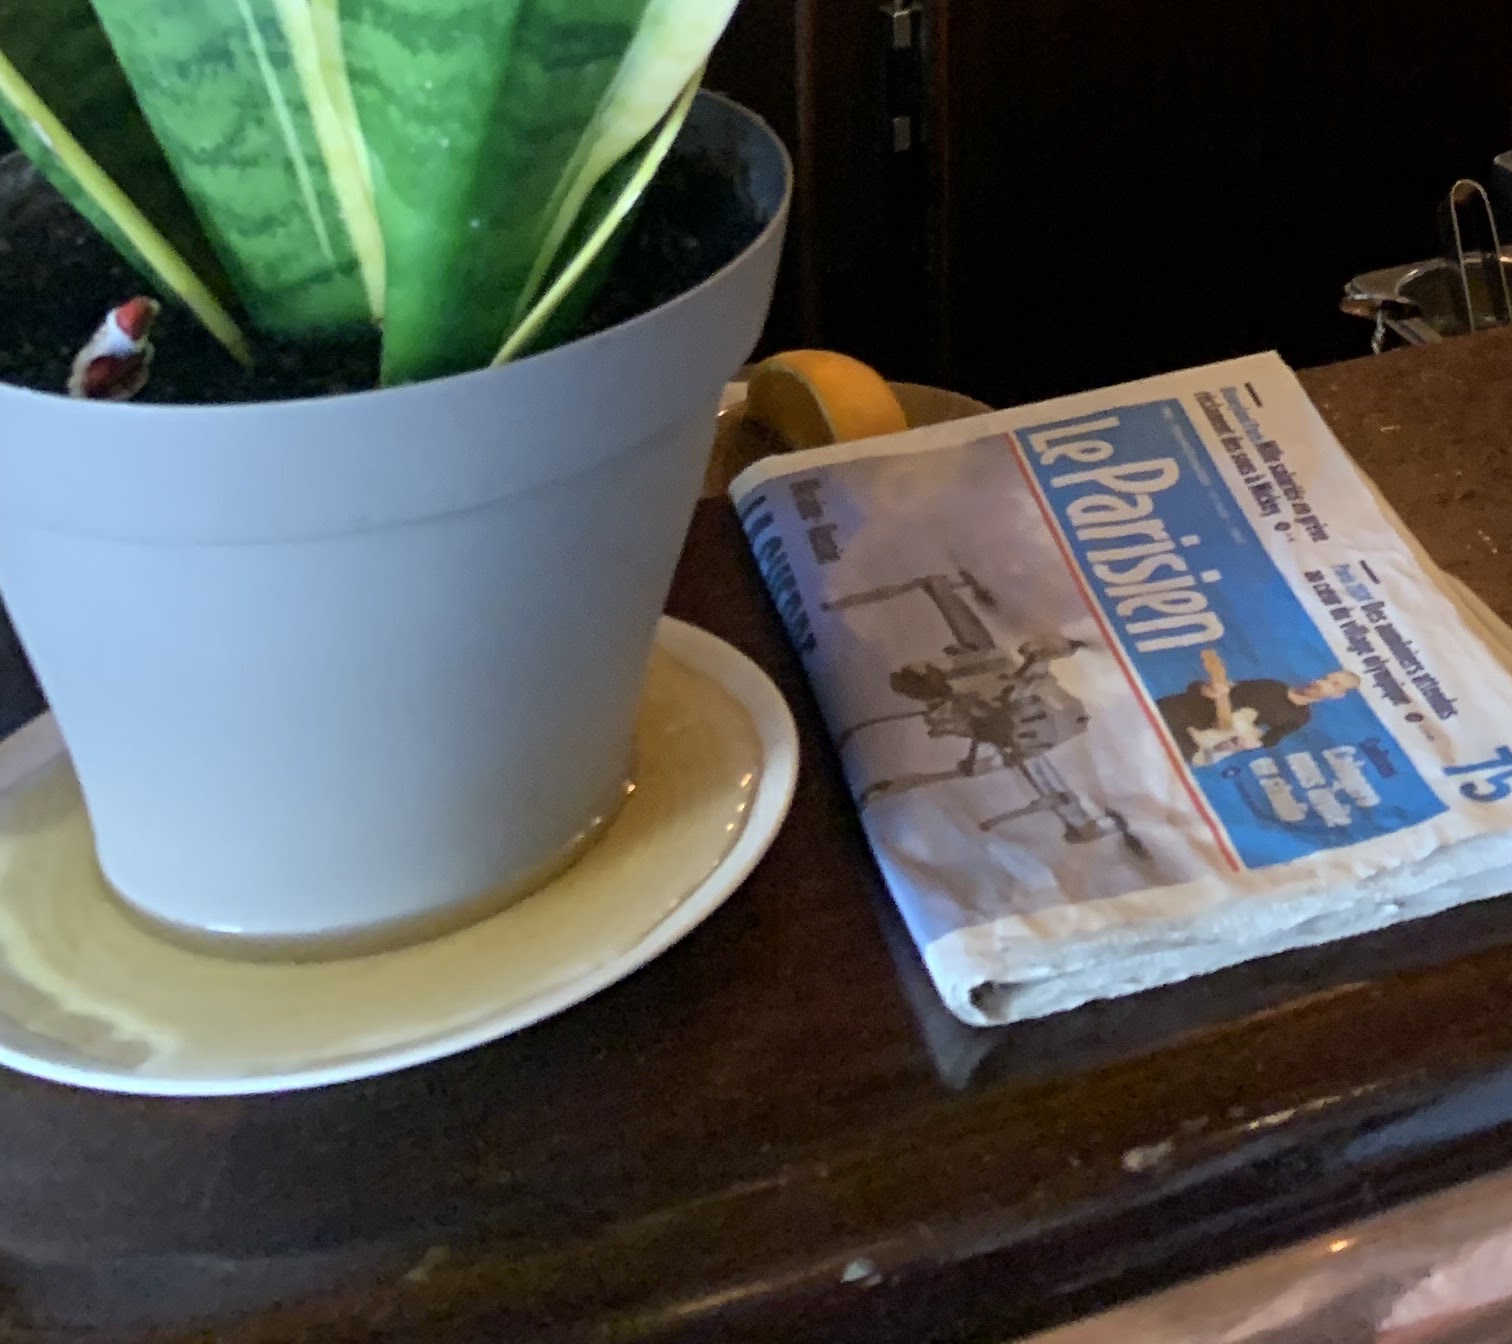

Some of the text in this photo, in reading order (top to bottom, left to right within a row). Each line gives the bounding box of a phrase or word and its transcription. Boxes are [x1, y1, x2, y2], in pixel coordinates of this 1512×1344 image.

[1028, 416, 1121, 465] Le
[1220, 435, 1243, 453] des
[1230, 452, 1256, 475] sous
[1247, 481, 1281, 517] Mickey
[1294, 515, 1329, 542] grève
[1050, 458, 1224, 653] Parisien
[1338, 620, 1375, 656] village
[1362, 655, 1412, 706] olympique
[1359, 601, 1388, 623] Des
[1411, 673, 1459, 720] attendus
